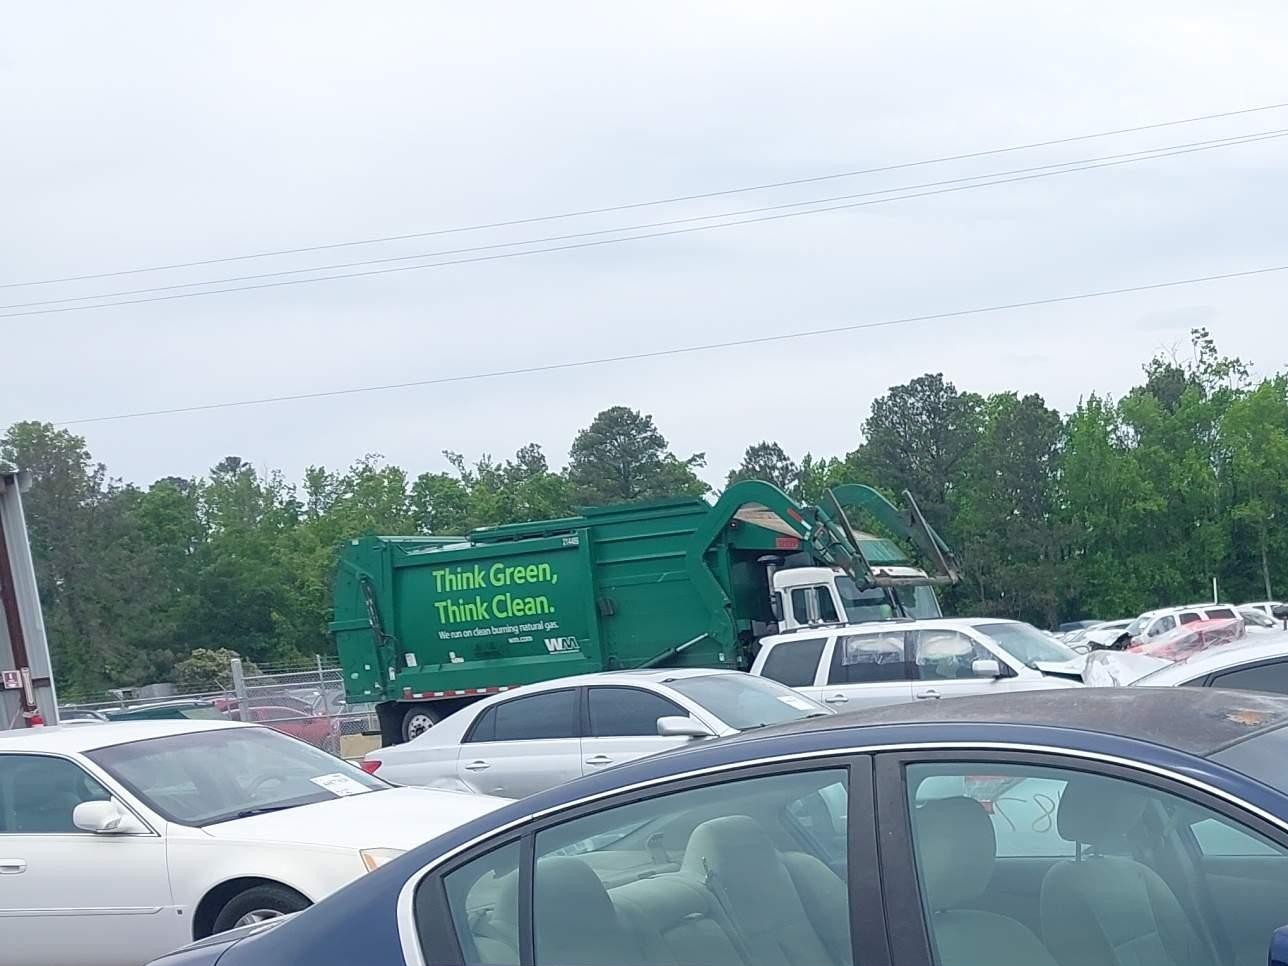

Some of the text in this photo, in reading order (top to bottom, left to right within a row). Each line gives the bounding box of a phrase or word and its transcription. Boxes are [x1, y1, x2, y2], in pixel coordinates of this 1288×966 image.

[432, 562, 558, 593] Think Green,
[434, 592, 556, 624] Think Clean.
[544, 636, 580, 652] WM
